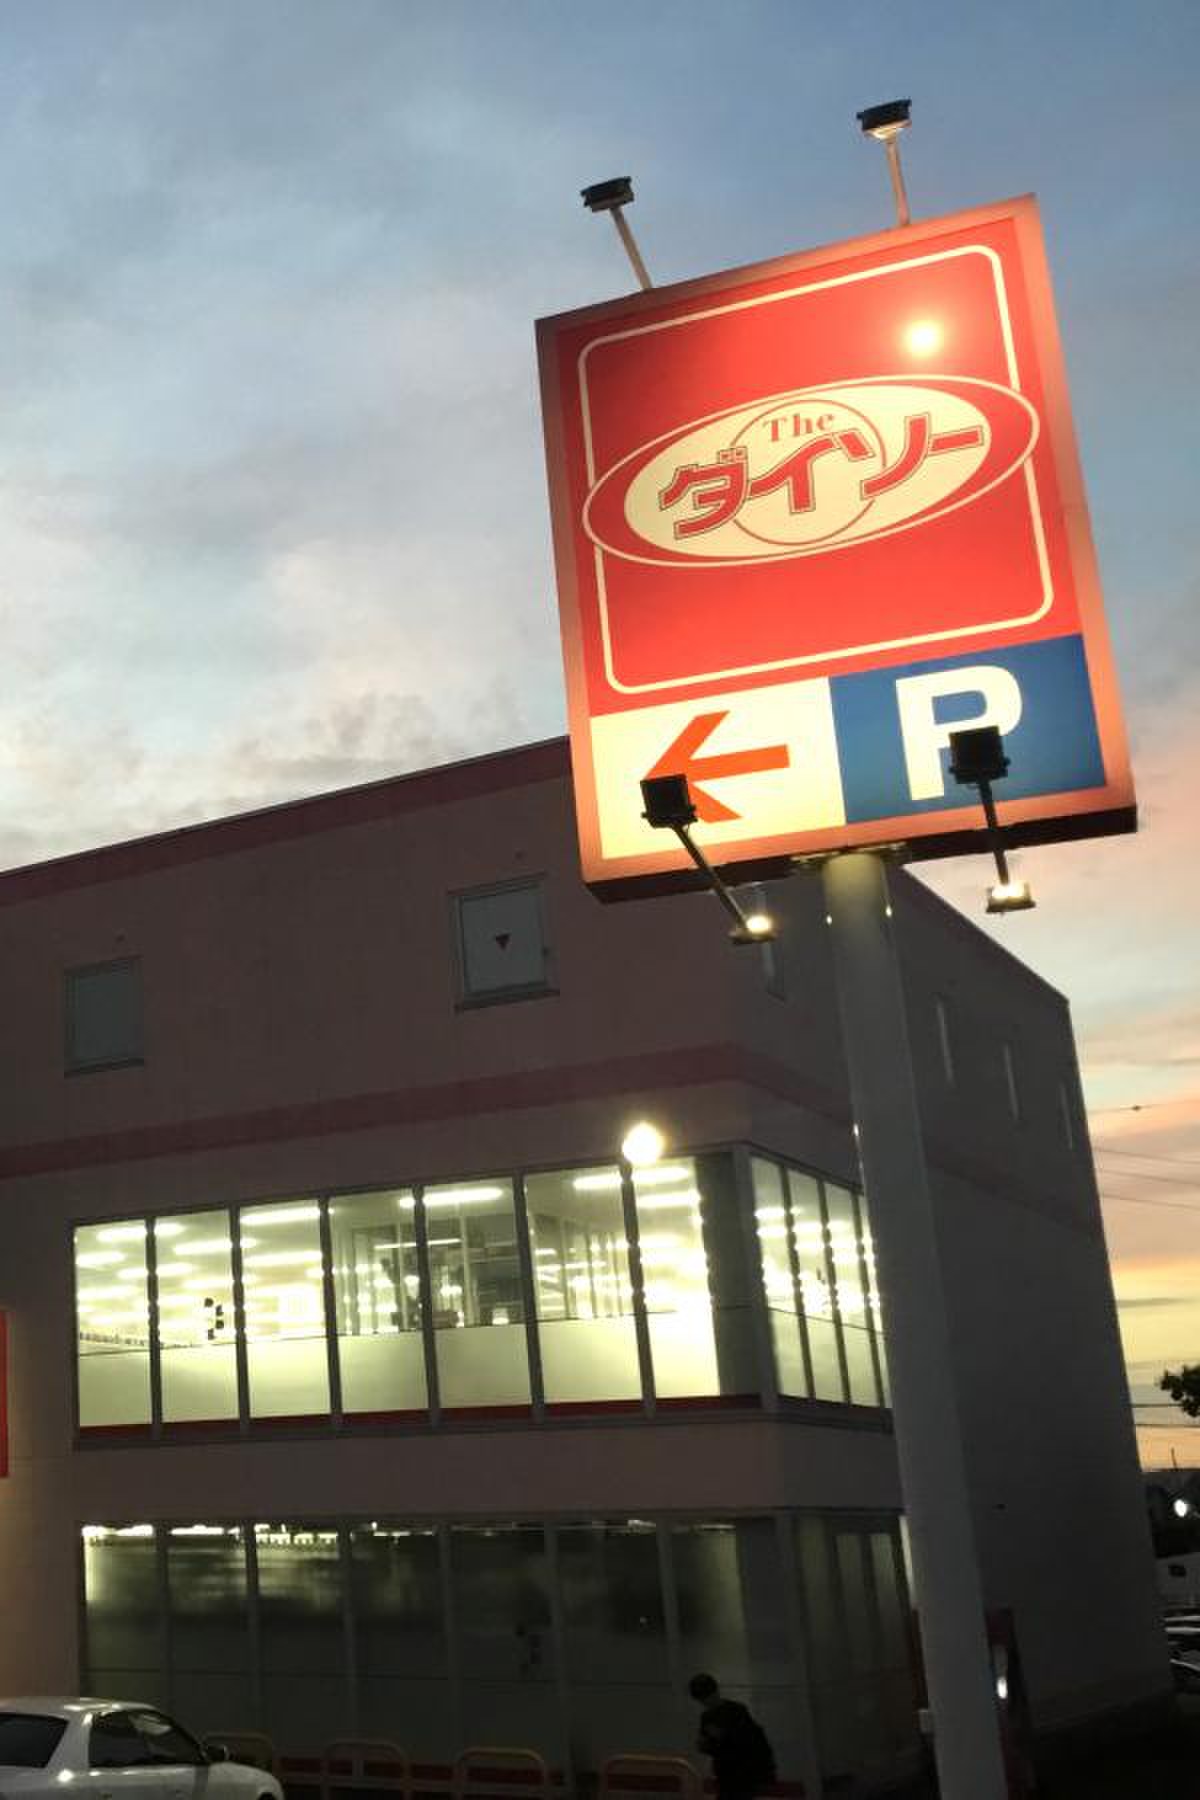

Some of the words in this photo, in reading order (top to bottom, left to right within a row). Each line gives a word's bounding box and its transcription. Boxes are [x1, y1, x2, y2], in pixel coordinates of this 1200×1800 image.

[658, 412, 984, 540] ダイソー
[763, 413, 835, 442] The
[895, 665, 1023, 801] P
